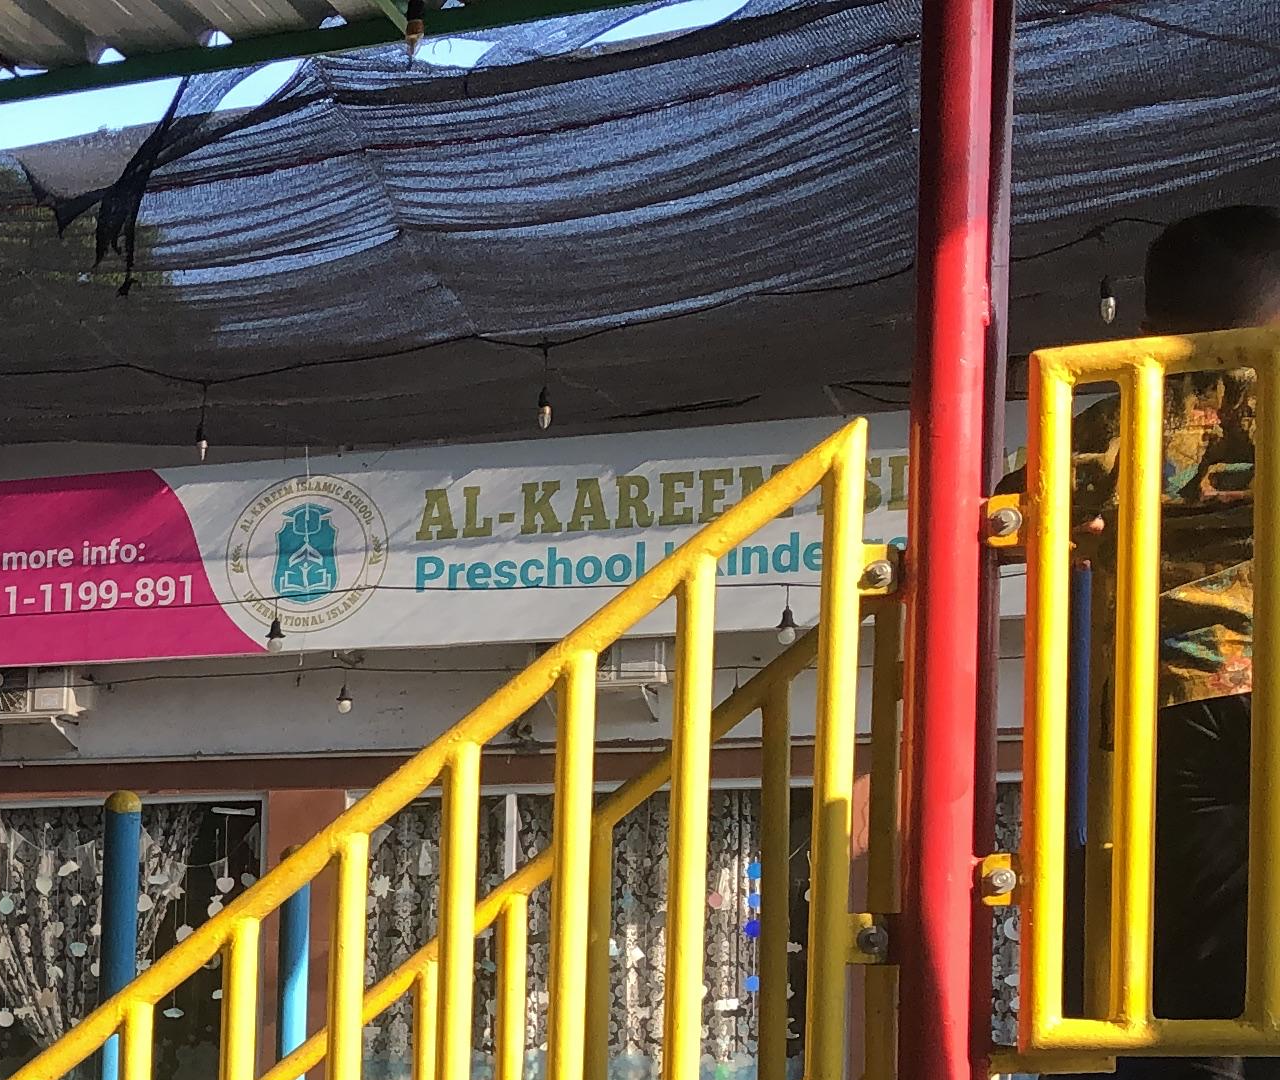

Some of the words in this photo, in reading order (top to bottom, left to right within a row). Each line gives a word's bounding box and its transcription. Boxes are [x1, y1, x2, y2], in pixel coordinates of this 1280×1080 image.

[240, 485, 293, 534] AL-KAREEM
[296, 480, 344, 497] ISLAMIC
[341, 489, 376, 527] SCHOOL
[2, 550, 74, 572] more
[82, 537, 146, 567] info:
[415, 540, 647, 594] Preschool
[242, 589, 326, 629] INTERNATIONAL
[326, 584, 366, 623] ISLAMIC
